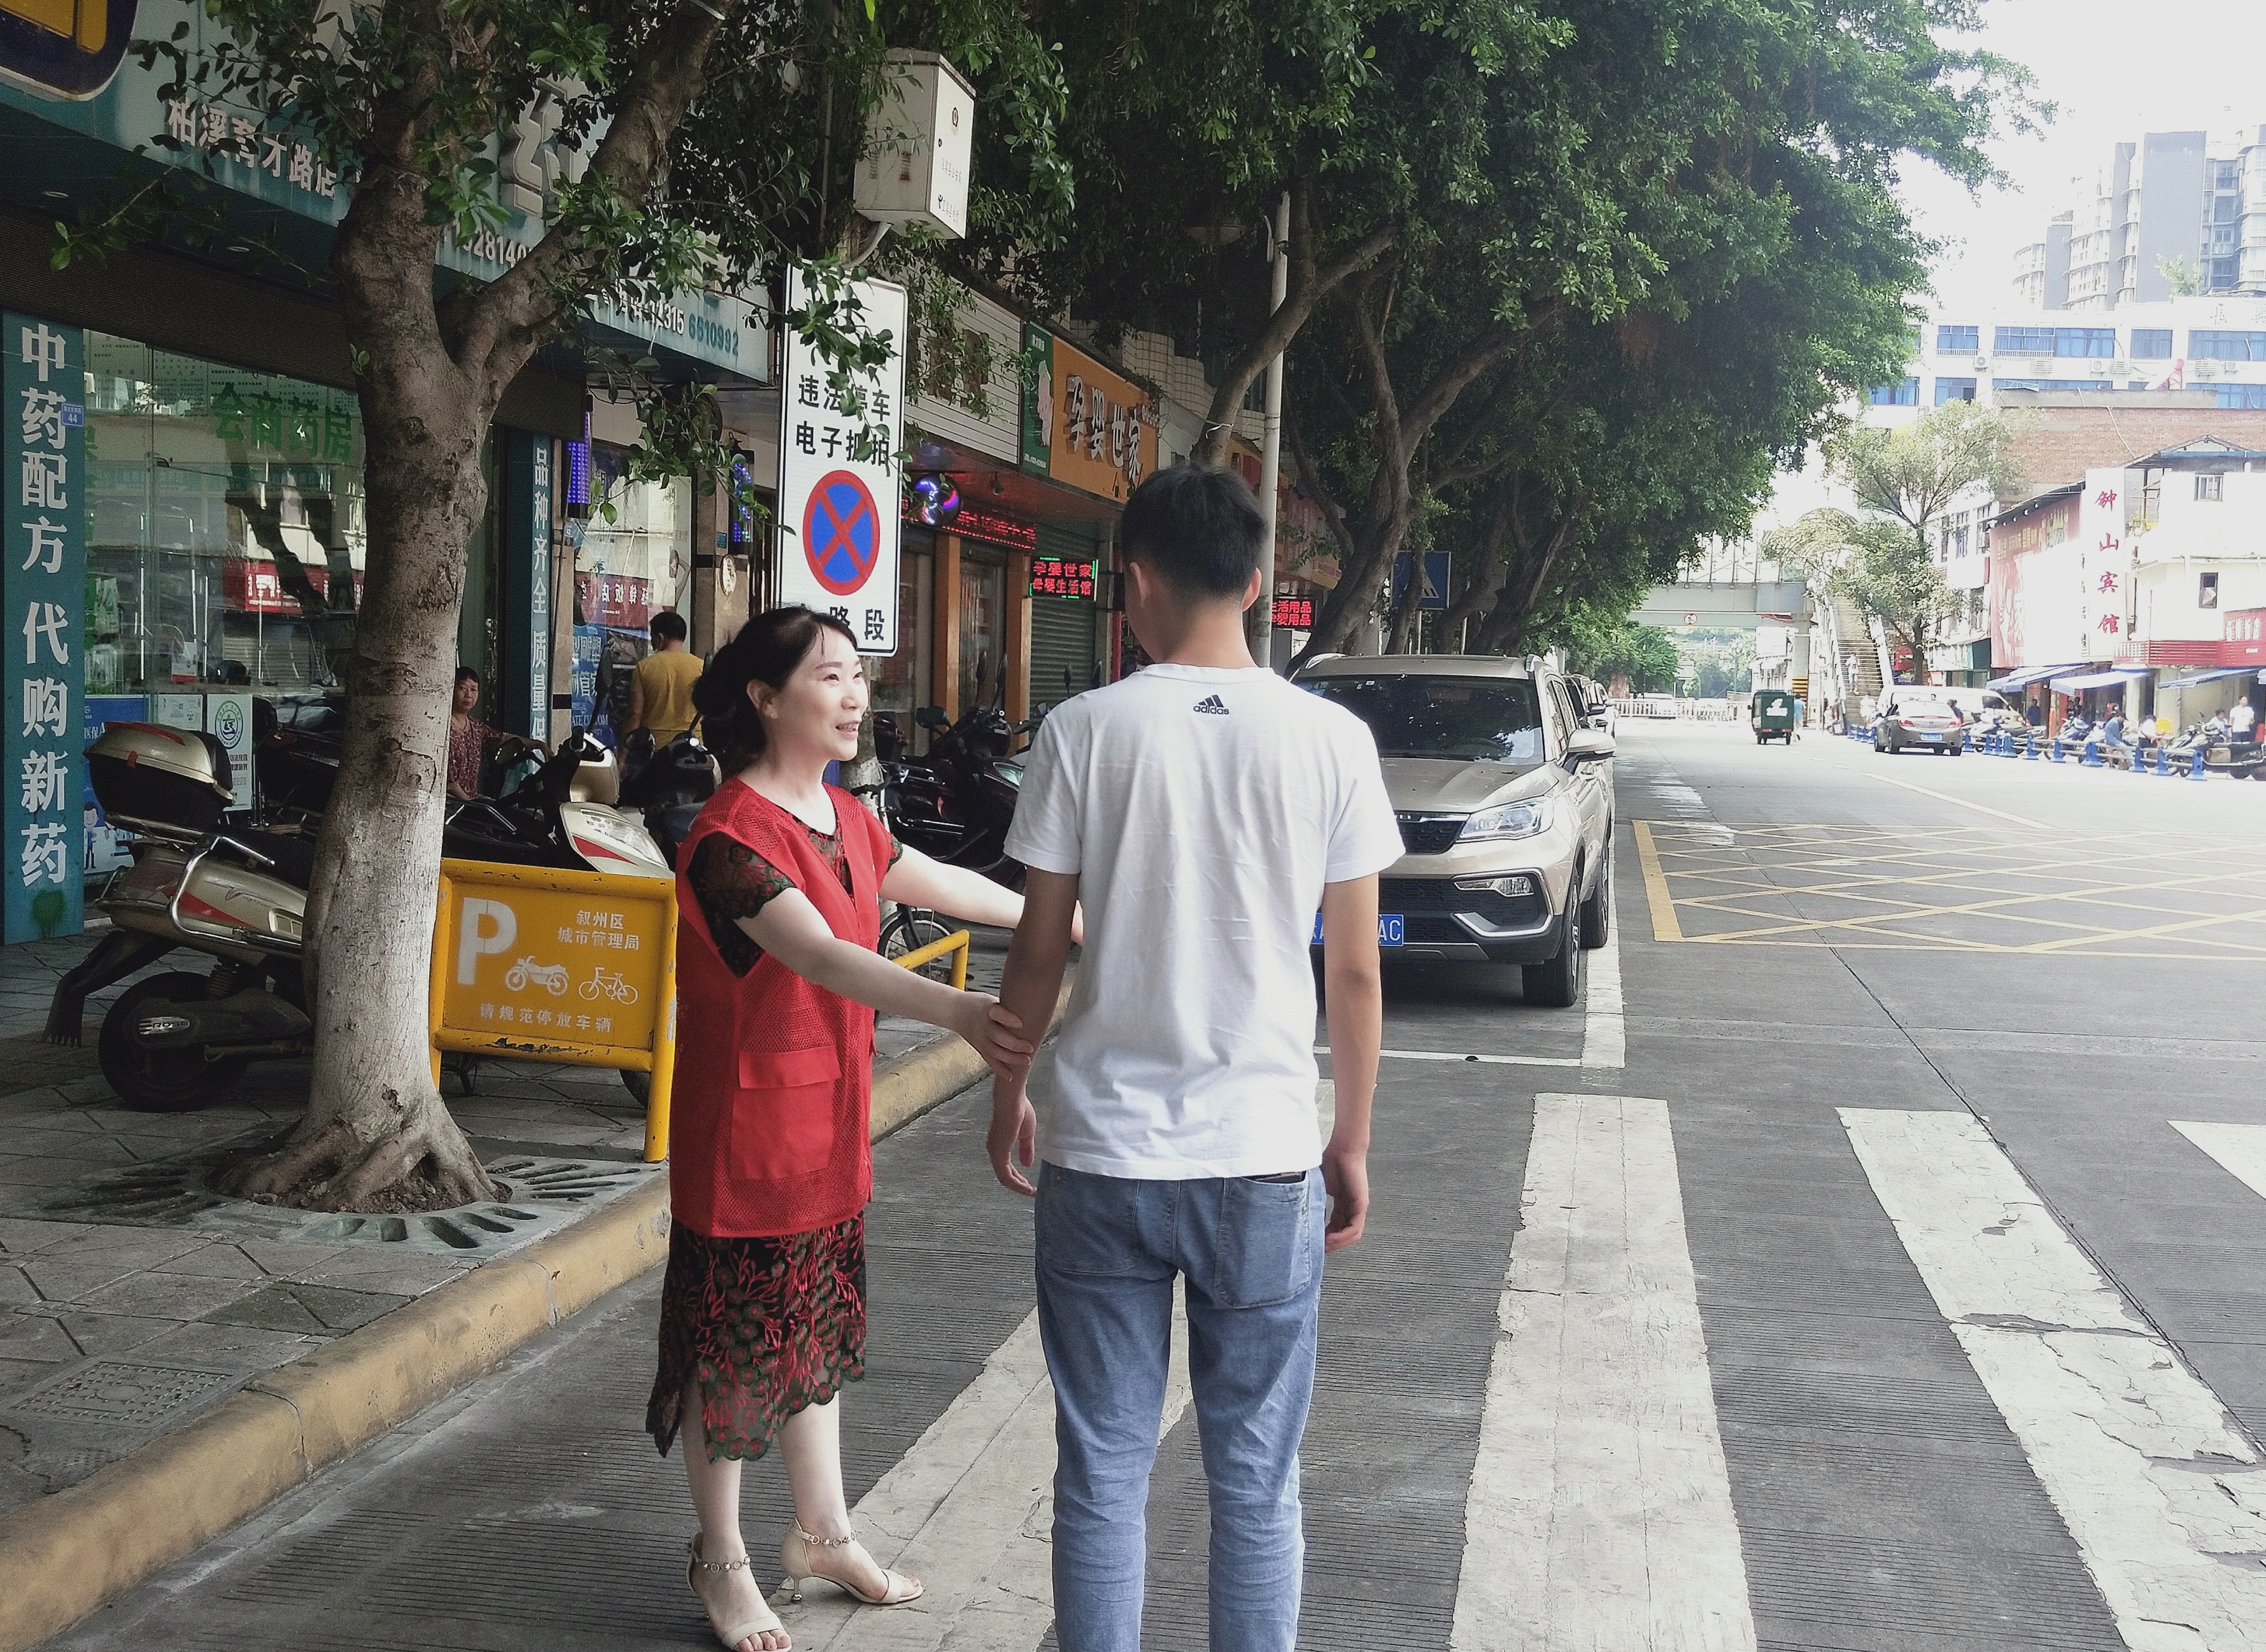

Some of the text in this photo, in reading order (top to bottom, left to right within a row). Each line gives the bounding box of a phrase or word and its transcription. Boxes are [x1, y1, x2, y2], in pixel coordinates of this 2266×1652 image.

[68, 413, 78, 424] 44
[1070, 376, 1140, 491] 孕婴世家
[533, 447, 549, 614] 品种齐全
[1033, 561, 1092, 577] 孕婴世家
[2095, 490, 2120, 634] 钟山宾馆
[1033, 577, 1092, 596] 母婴生活馆
[21, 323, 69, 888] 中药配方 代购新药
[1193, 705, 1229, 715] adidas
[576, 909, 625, 930] 叙州区
[458, 898, 516, 985] P
[557, 927, 640, 951] 城市管理局
[479, 1002, 612, 1033] 请规范停放车辆
